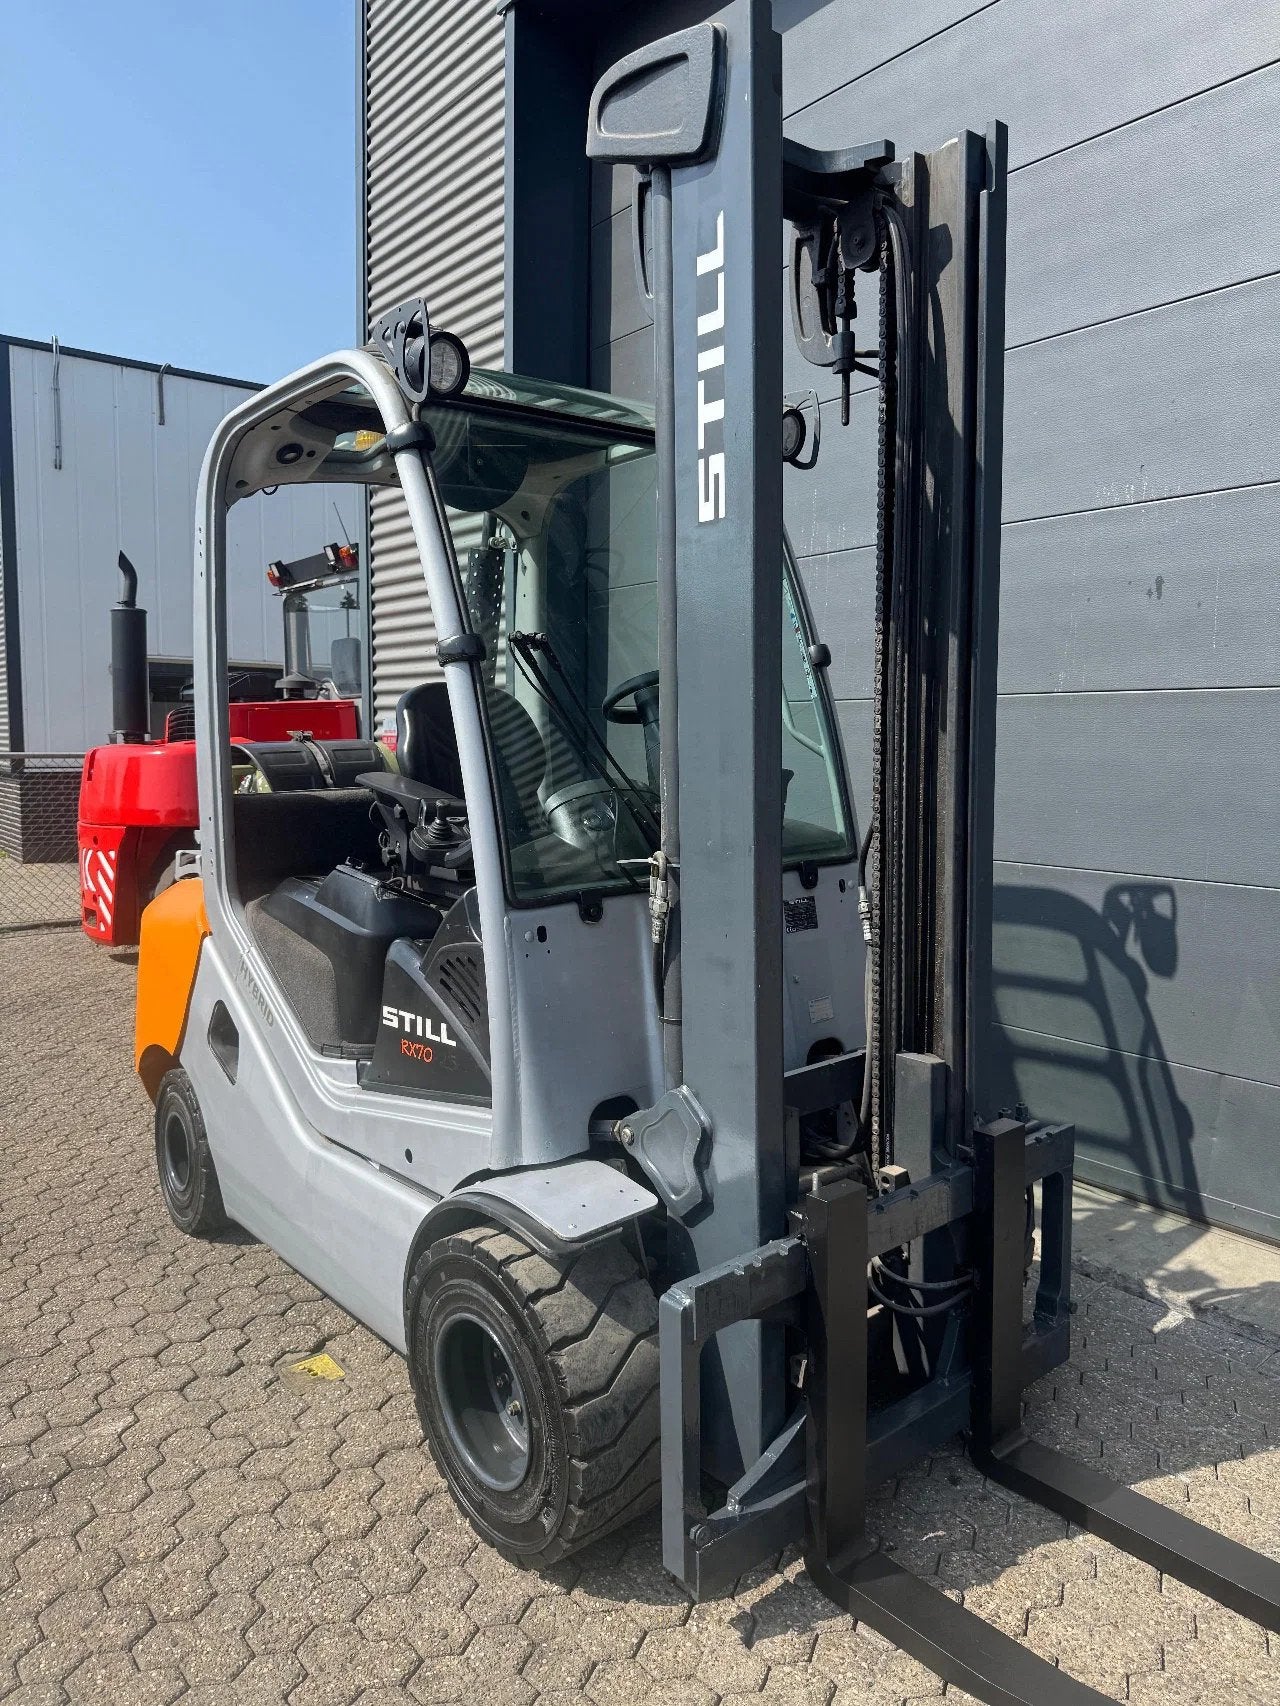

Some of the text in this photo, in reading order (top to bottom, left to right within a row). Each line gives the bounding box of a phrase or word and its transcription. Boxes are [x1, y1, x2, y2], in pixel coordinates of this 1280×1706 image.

[697, 209, 726, 523] STILL
[382, 1005, 457, 1047] STILL
[400, 1038, 433, 1063] RX70
